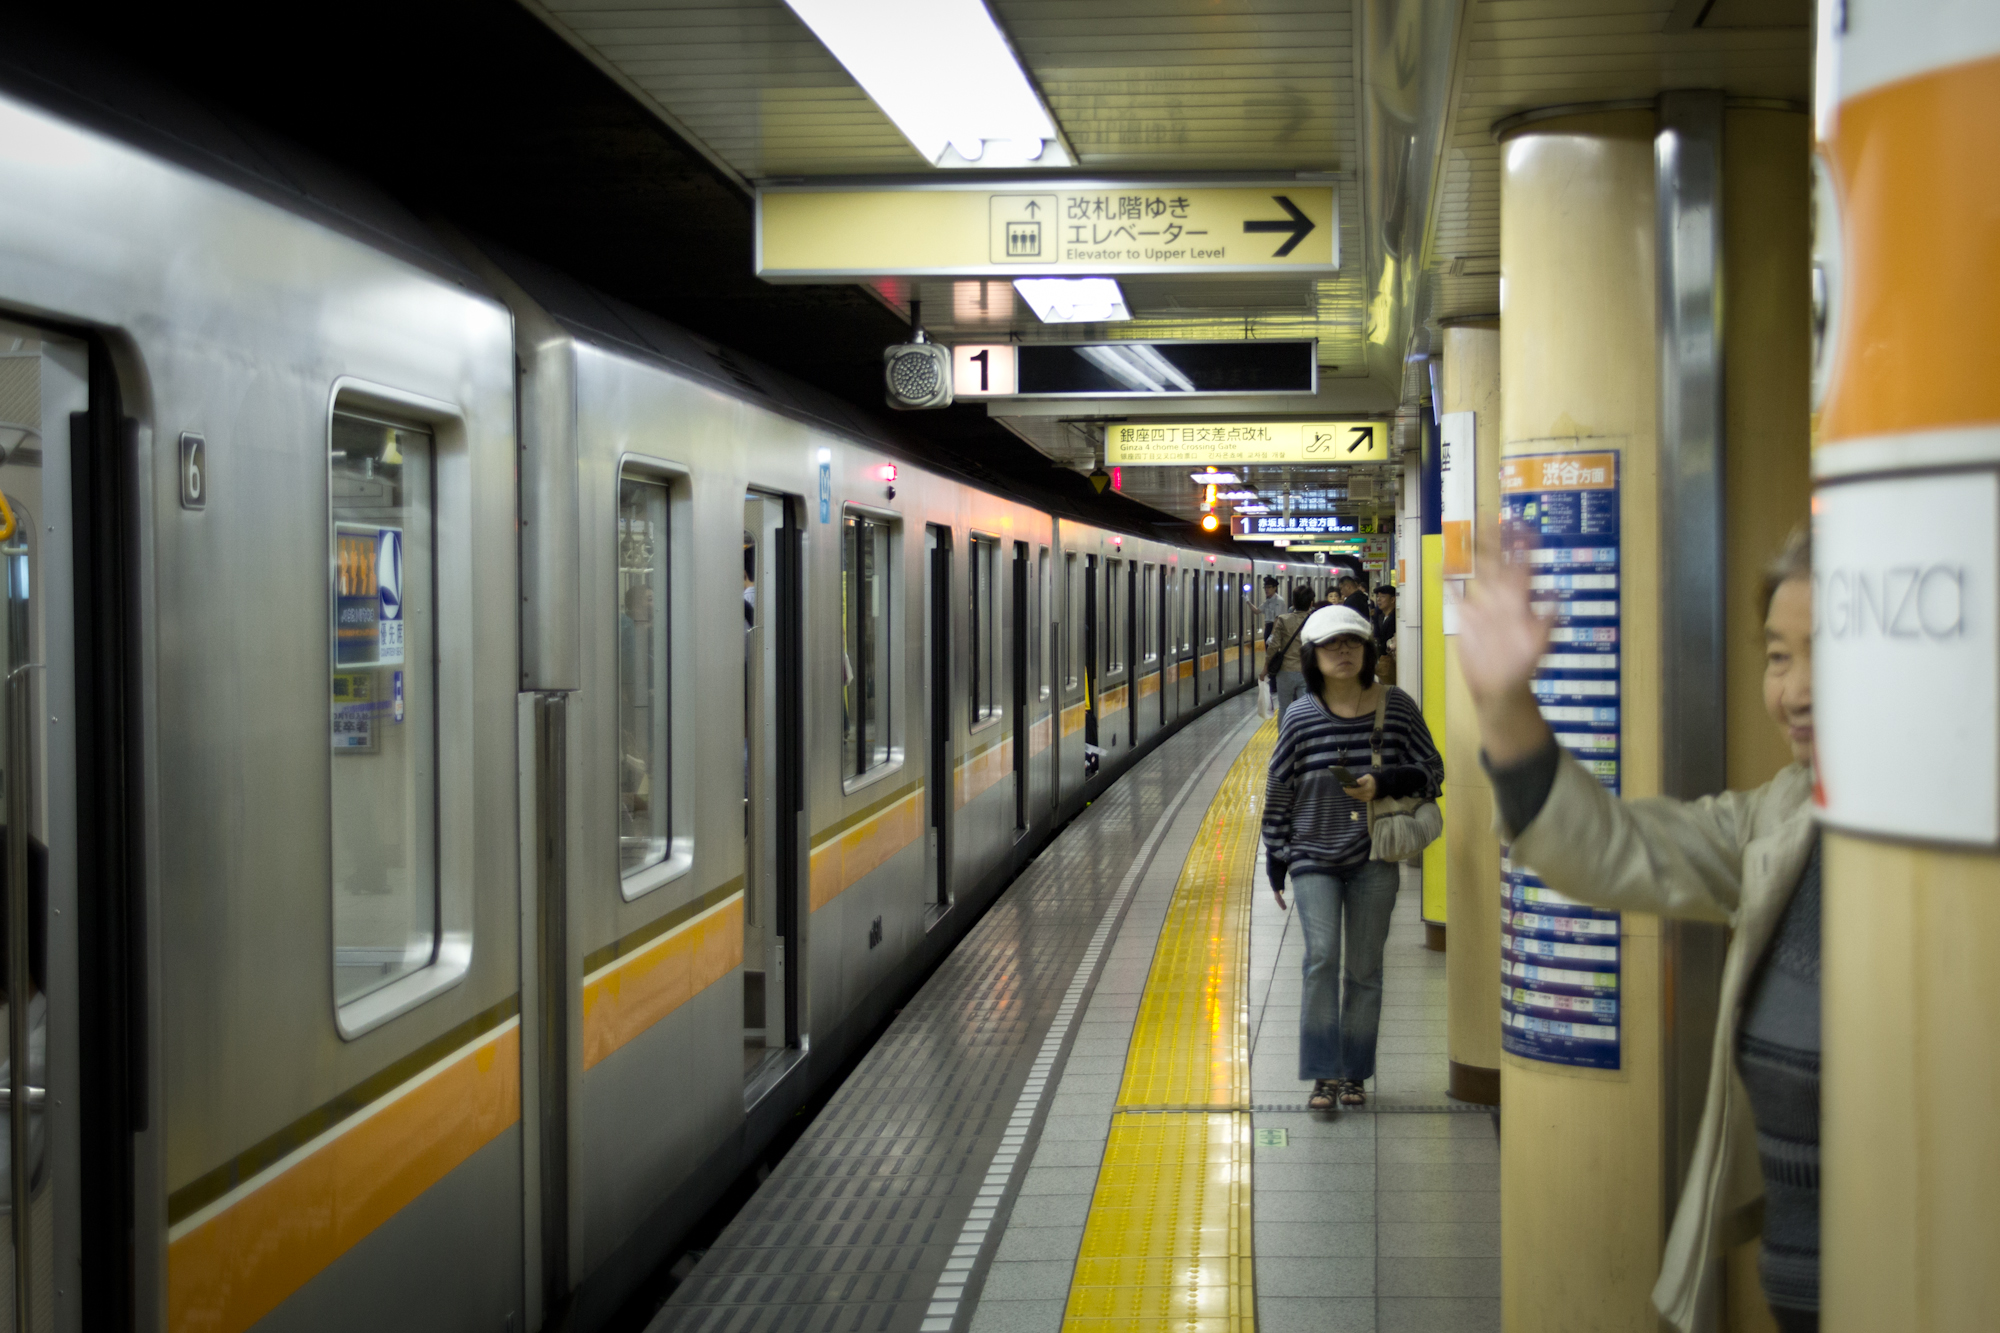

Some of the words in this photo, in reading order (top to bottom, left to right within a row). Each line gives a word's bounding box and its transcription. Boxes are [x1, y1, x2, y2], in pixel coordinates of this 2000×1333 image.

[1067, 196, 1190, 221] 改札階ゆき
[1067, 223, 1208, 245] エレベーター
[1066, 248, 1122, 260] Elevator
[1126, 249, 1140, 260] to
[1145, 248, 1186, 262] Upper
[1190, 247, 1225, 259] Level
[970, 349, 989, 391] 1
[1120, 427, 1272, 442] 銀座四丁目交差点改札
[1181, 443, 1216, 452] Crossing
[189, 443, 200, 499] 6
[1240, 517, 1250, 533] 1
